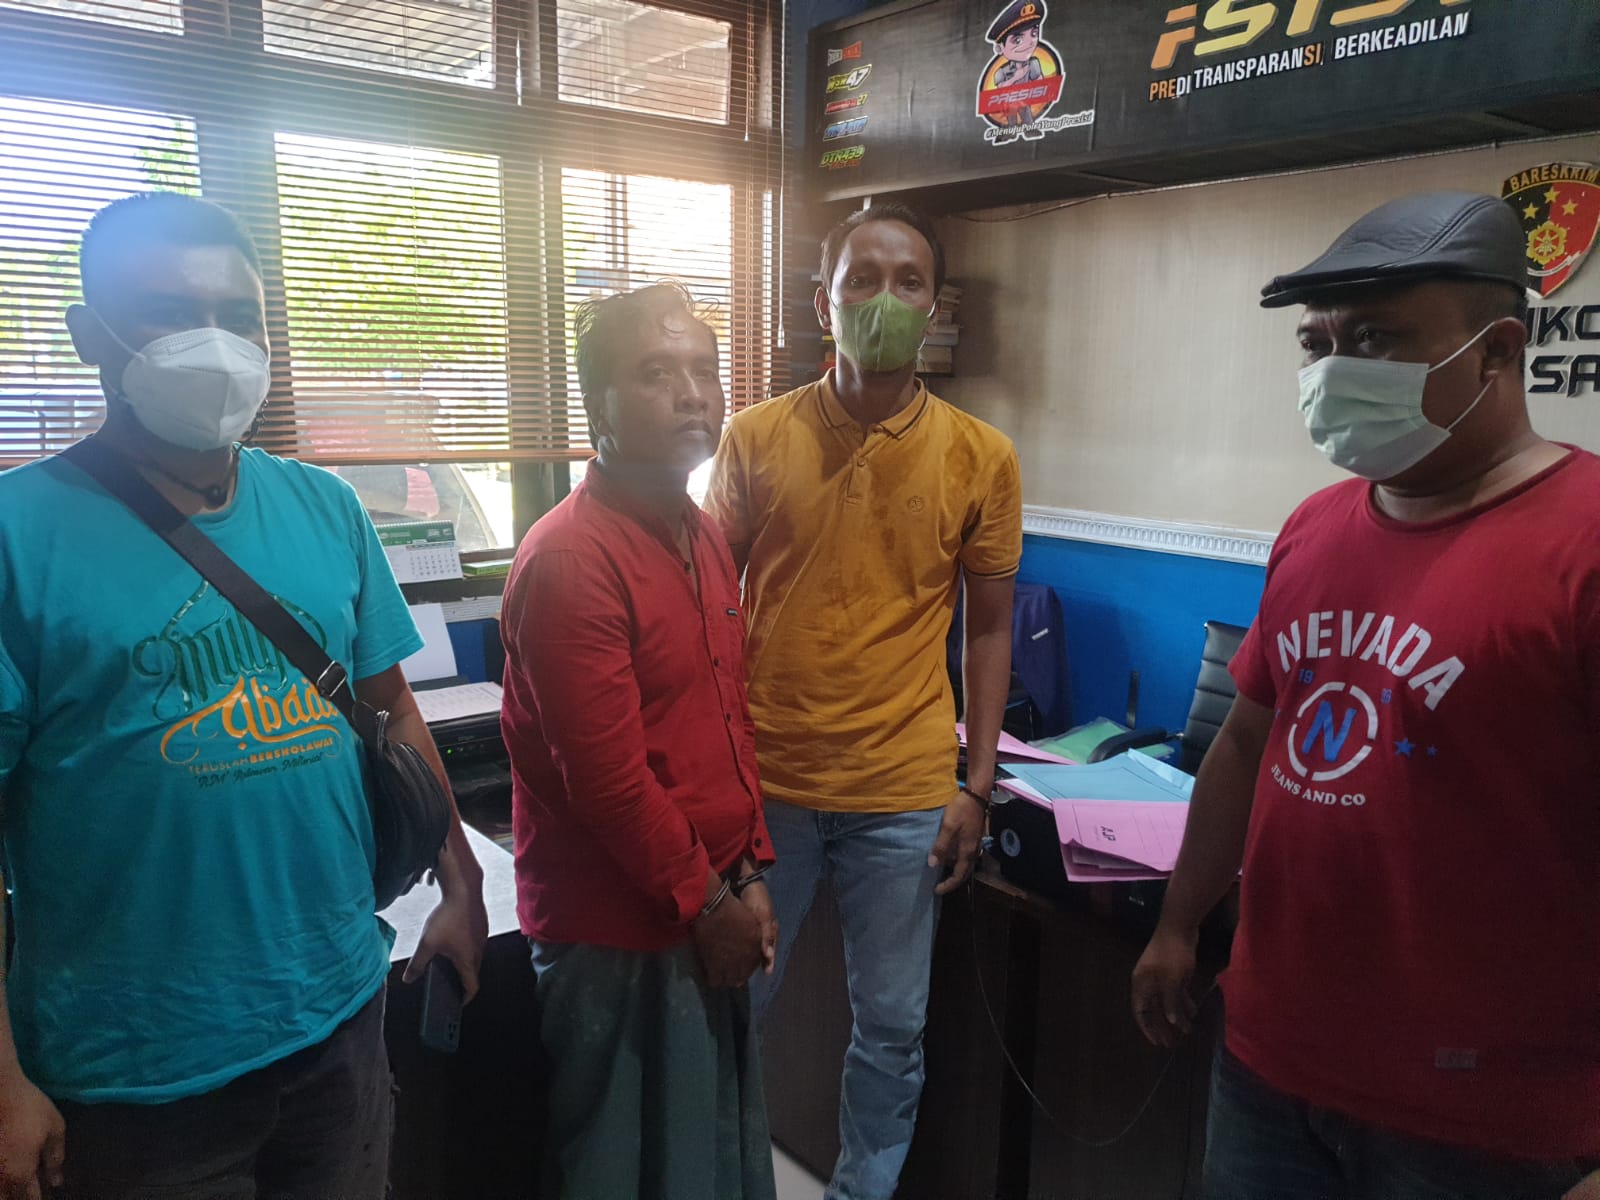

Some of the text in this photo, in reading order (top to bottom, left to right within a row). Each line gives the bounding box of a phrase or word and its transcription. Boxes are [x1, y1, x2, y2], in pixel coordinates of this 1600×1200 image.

[1334, 12, 1469, 60] BERKEADILAN
[987, 86, 1048, 107] PRESISI
[1510, 164, 1599, 192] BARESKRIM
[1528, 354, 1600, 397] SA
[1276, 610, 1466, 711] NEVADA
[1301, 700, 1357, 762] N
[1271, 764, 1366, 806] JEANS AND CO
